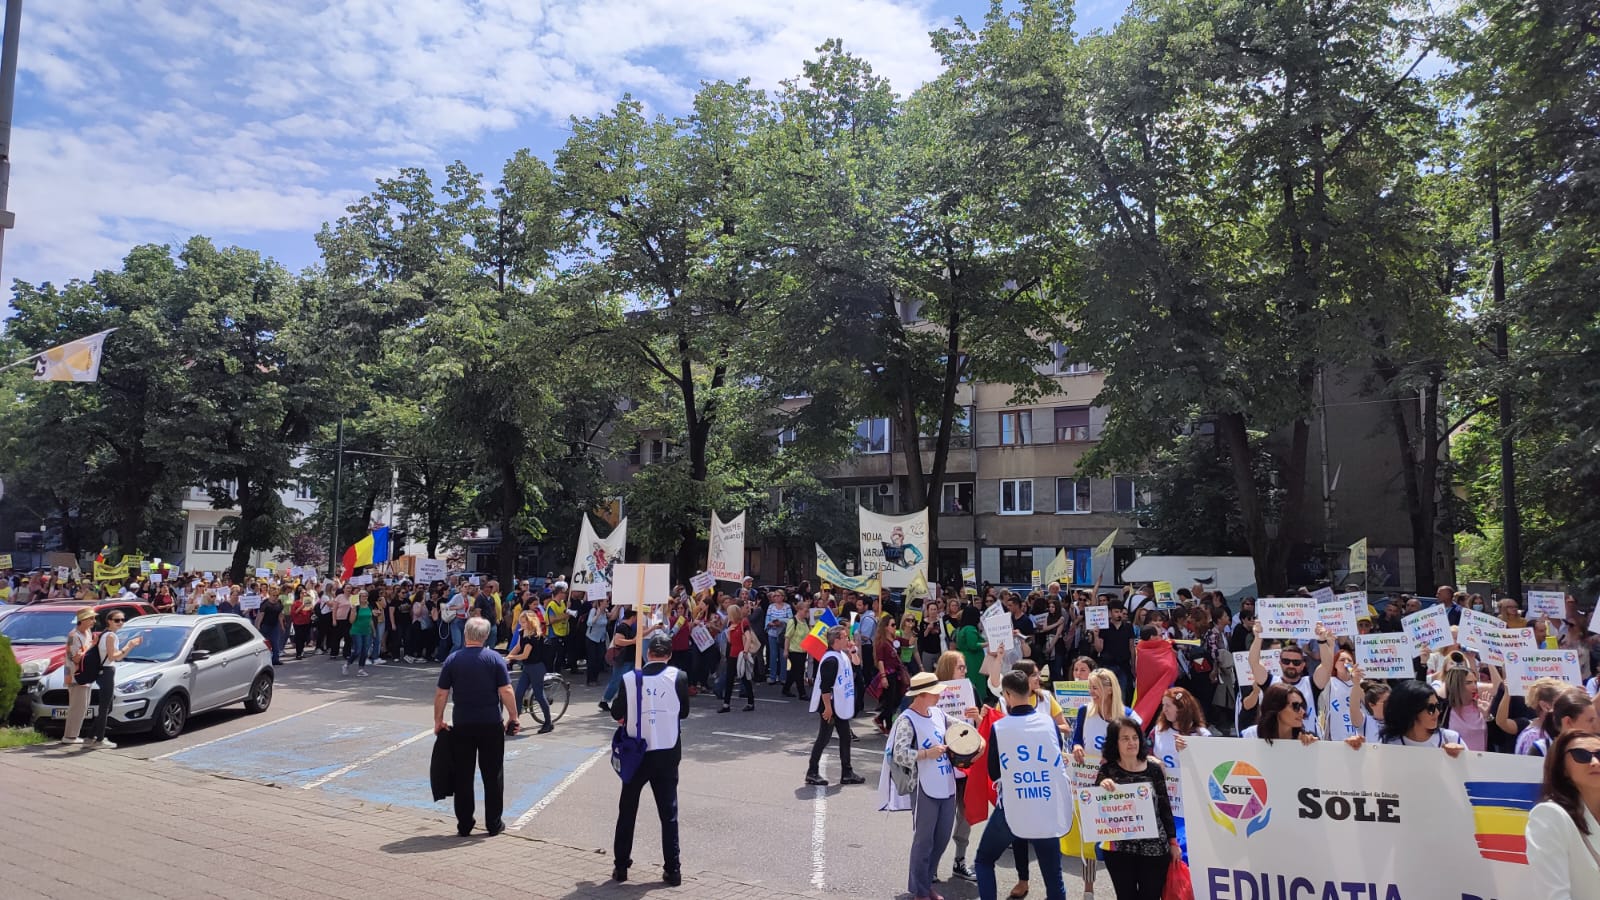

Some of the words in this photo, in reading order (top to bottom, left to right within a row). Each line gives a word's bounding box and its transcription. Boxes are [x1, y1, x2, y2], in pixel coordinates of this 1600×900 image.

[862, 532, 882, 542] NOUA
[1014, 770, 1050, 784] SOLE
[1075, 772, 1098, 780] EDUCA
[1015, 786, 1052, 801] TIMIȘ
[1222, 784, 1252, 796] SOLE
[1096, 794, 1107, 802] UN
[1108, 792, 1136, 800] POPOR
[1102, 804, 1132, 812] EDUCAT
[1298, 788, 1400, 823] SOLE
[1108, 816, 1134, 824] POATE
